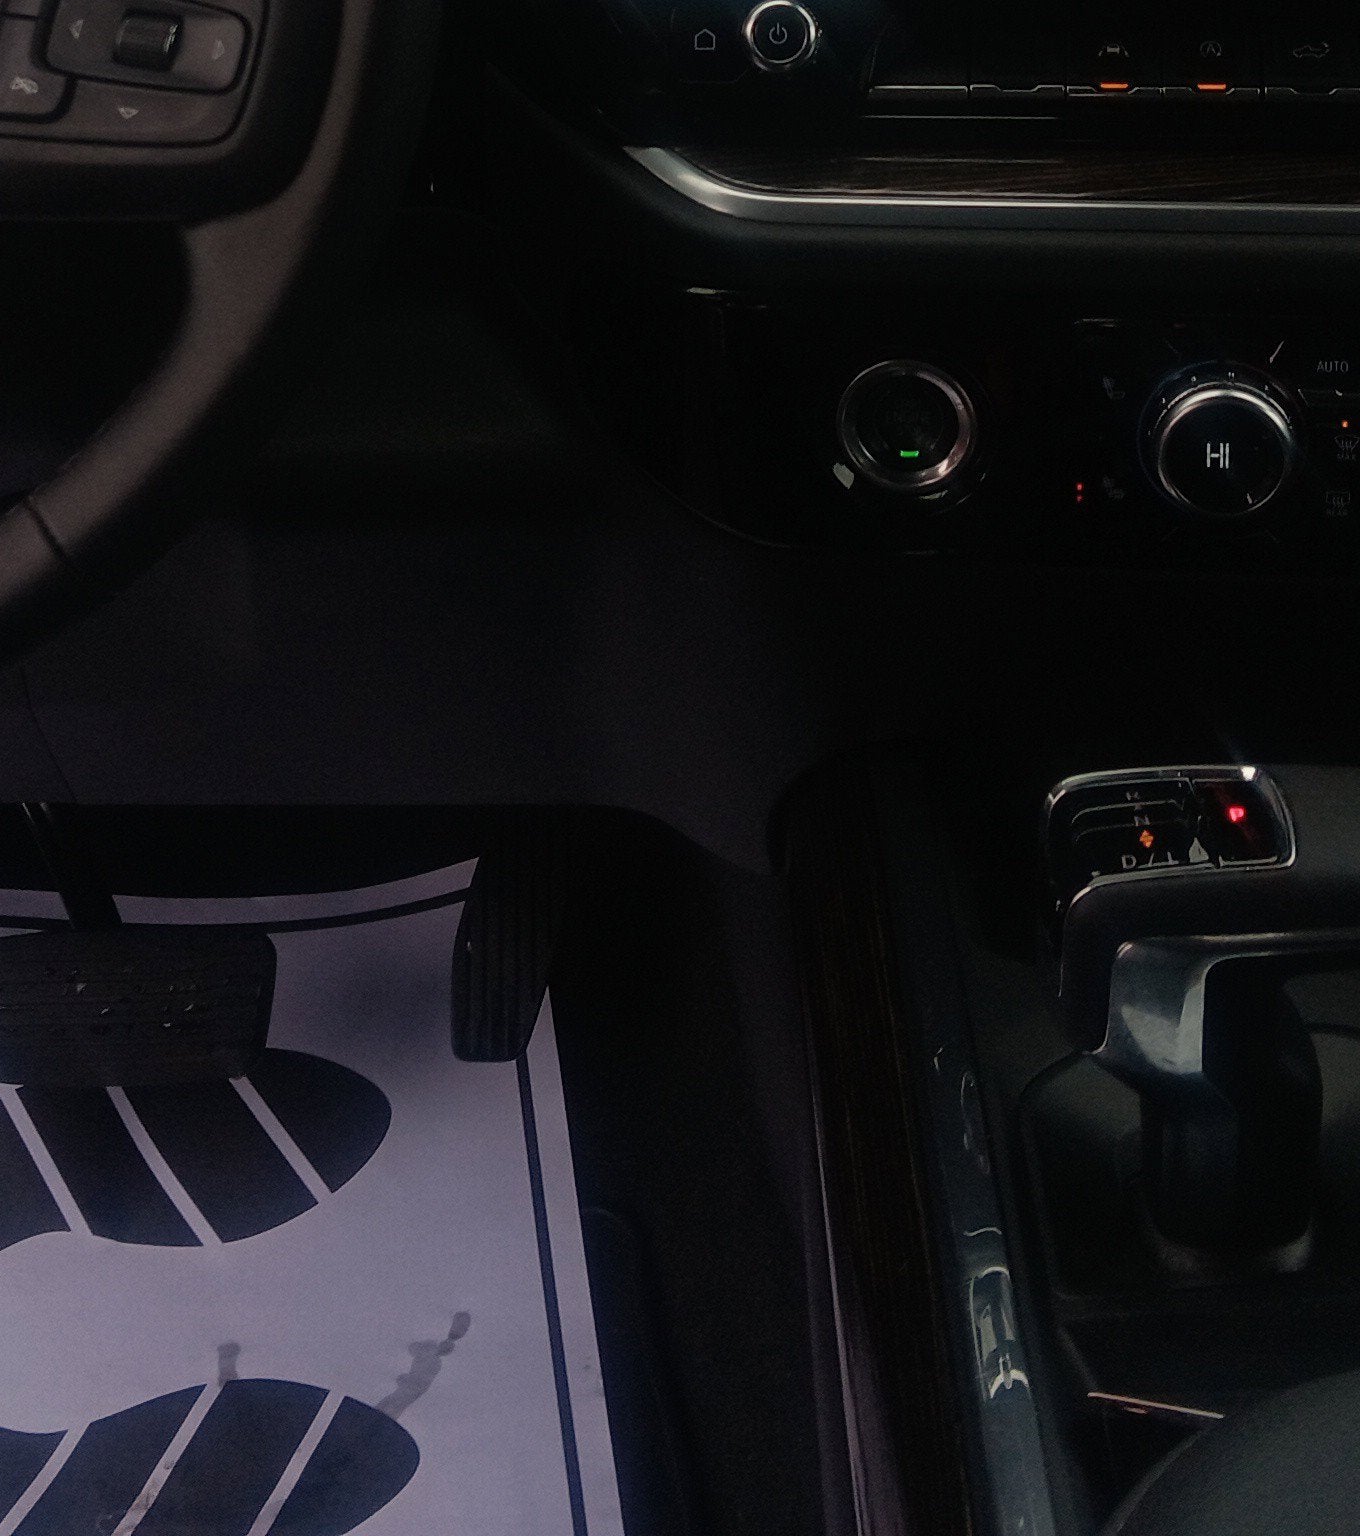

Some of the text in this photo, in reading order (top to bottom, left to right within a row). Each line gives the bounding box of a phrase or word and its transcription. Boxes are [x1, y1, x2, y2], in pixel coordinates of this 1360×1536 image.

[1316, 360, 1350, 374] AUTO
[1206, 442, 1230, 469] HI
[1133, 814, 1150, 827] N
[1228, 804, 1246, 823] P
